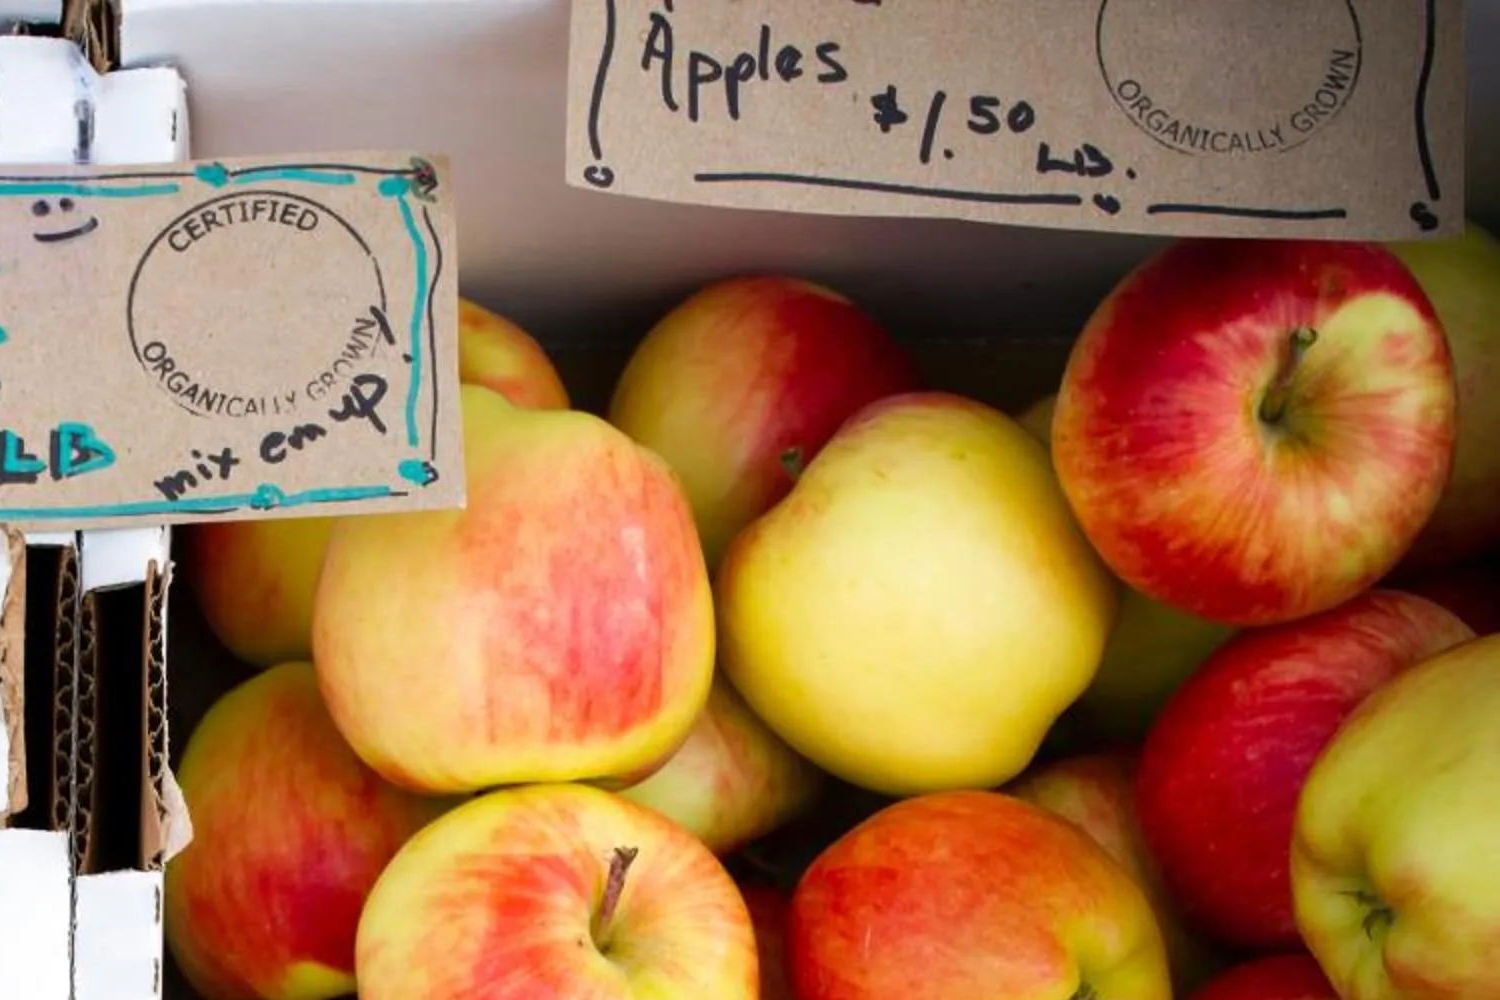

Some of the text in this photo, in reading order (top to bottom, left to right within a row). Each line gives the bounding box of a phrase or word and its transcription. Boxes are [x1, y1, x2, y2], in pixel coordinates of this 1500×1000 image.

[641, 11, 848, 122] Apples
[1116, 48, 1356, 153] ORGANICALLY GROWN
[870, 84, 1036, 165] $1.50
[166, 198, 320, 254] CERTIFIED
[305, 316, 377, 402] GROWN
[152, 447, 241, 501] mix
